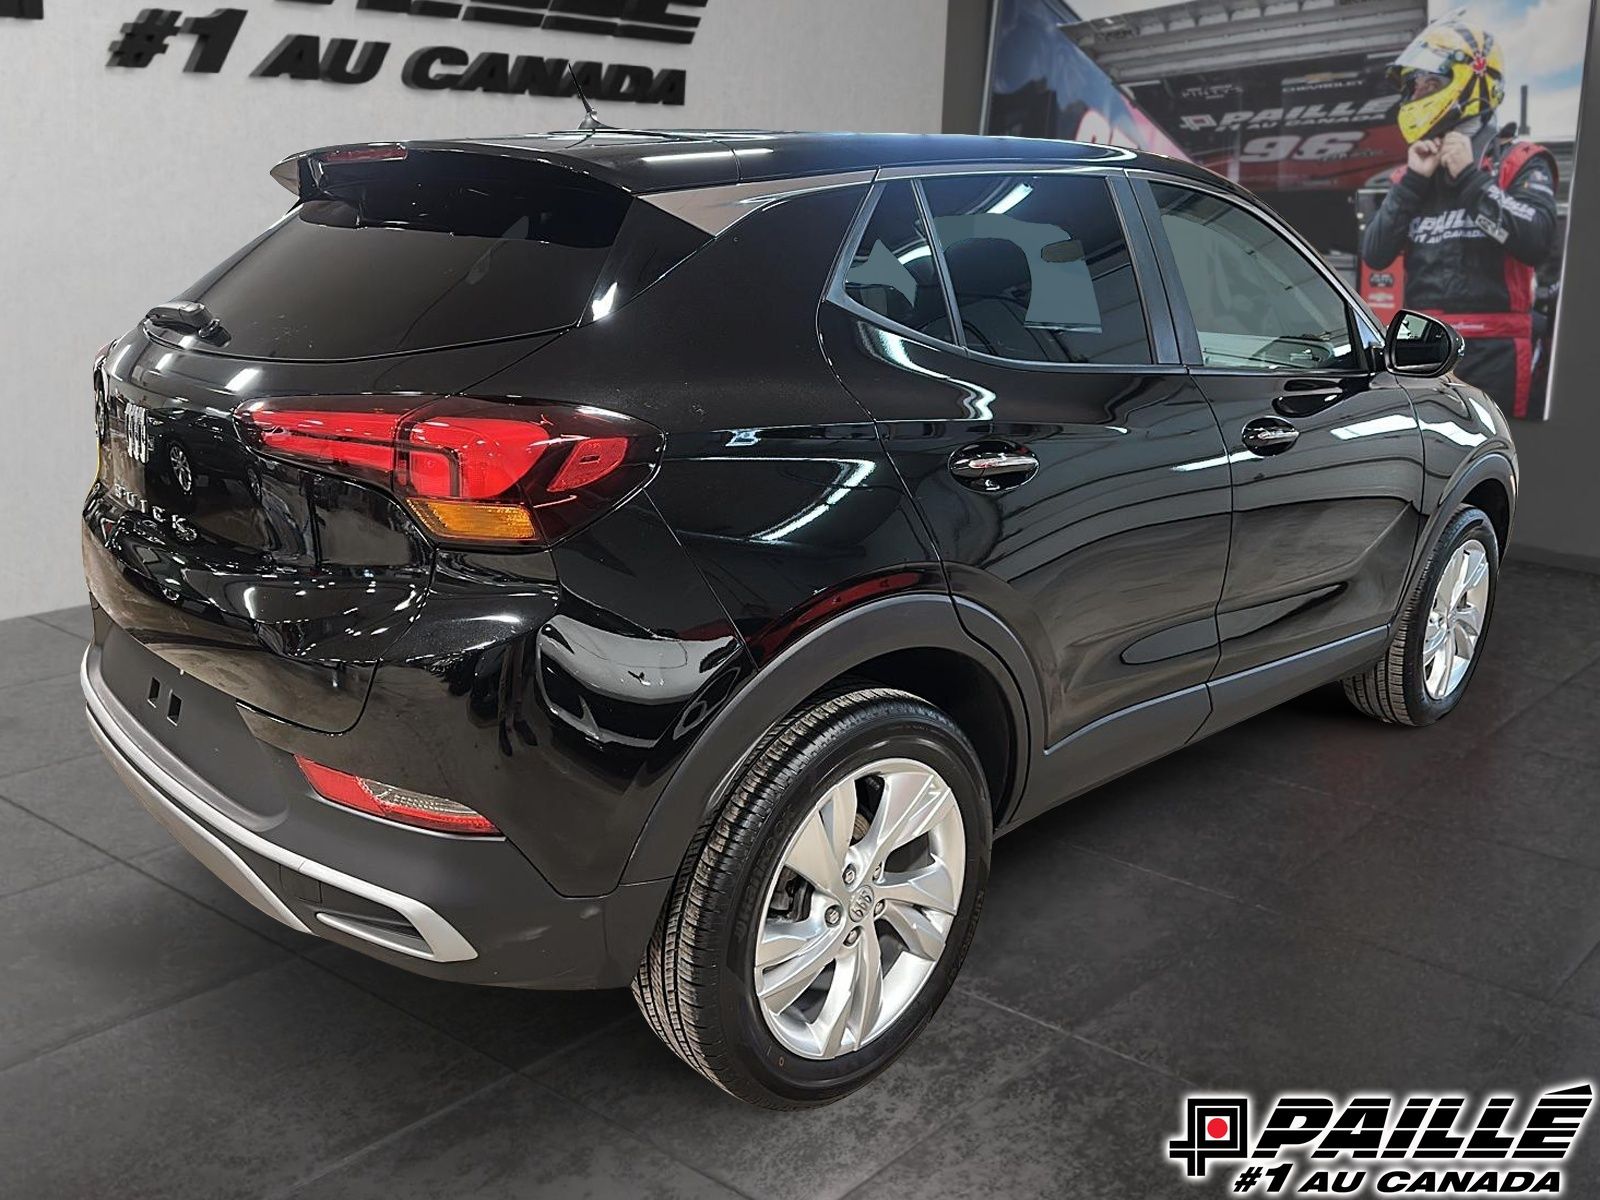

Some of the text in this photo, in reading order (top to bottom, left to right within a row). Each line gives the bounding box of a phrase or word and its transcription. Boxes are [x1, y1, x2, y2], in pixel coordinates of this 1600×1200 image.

[106, 9, 247, 74] #1
[249, 34, 391, 84] AU
[401, 46, 686, 106] CANADA
[1282, 79, 1364, 93] CHEVROLET
[1285, 113, 1386, 127] CANADA
[1239, 131, 1365, 163] 96
